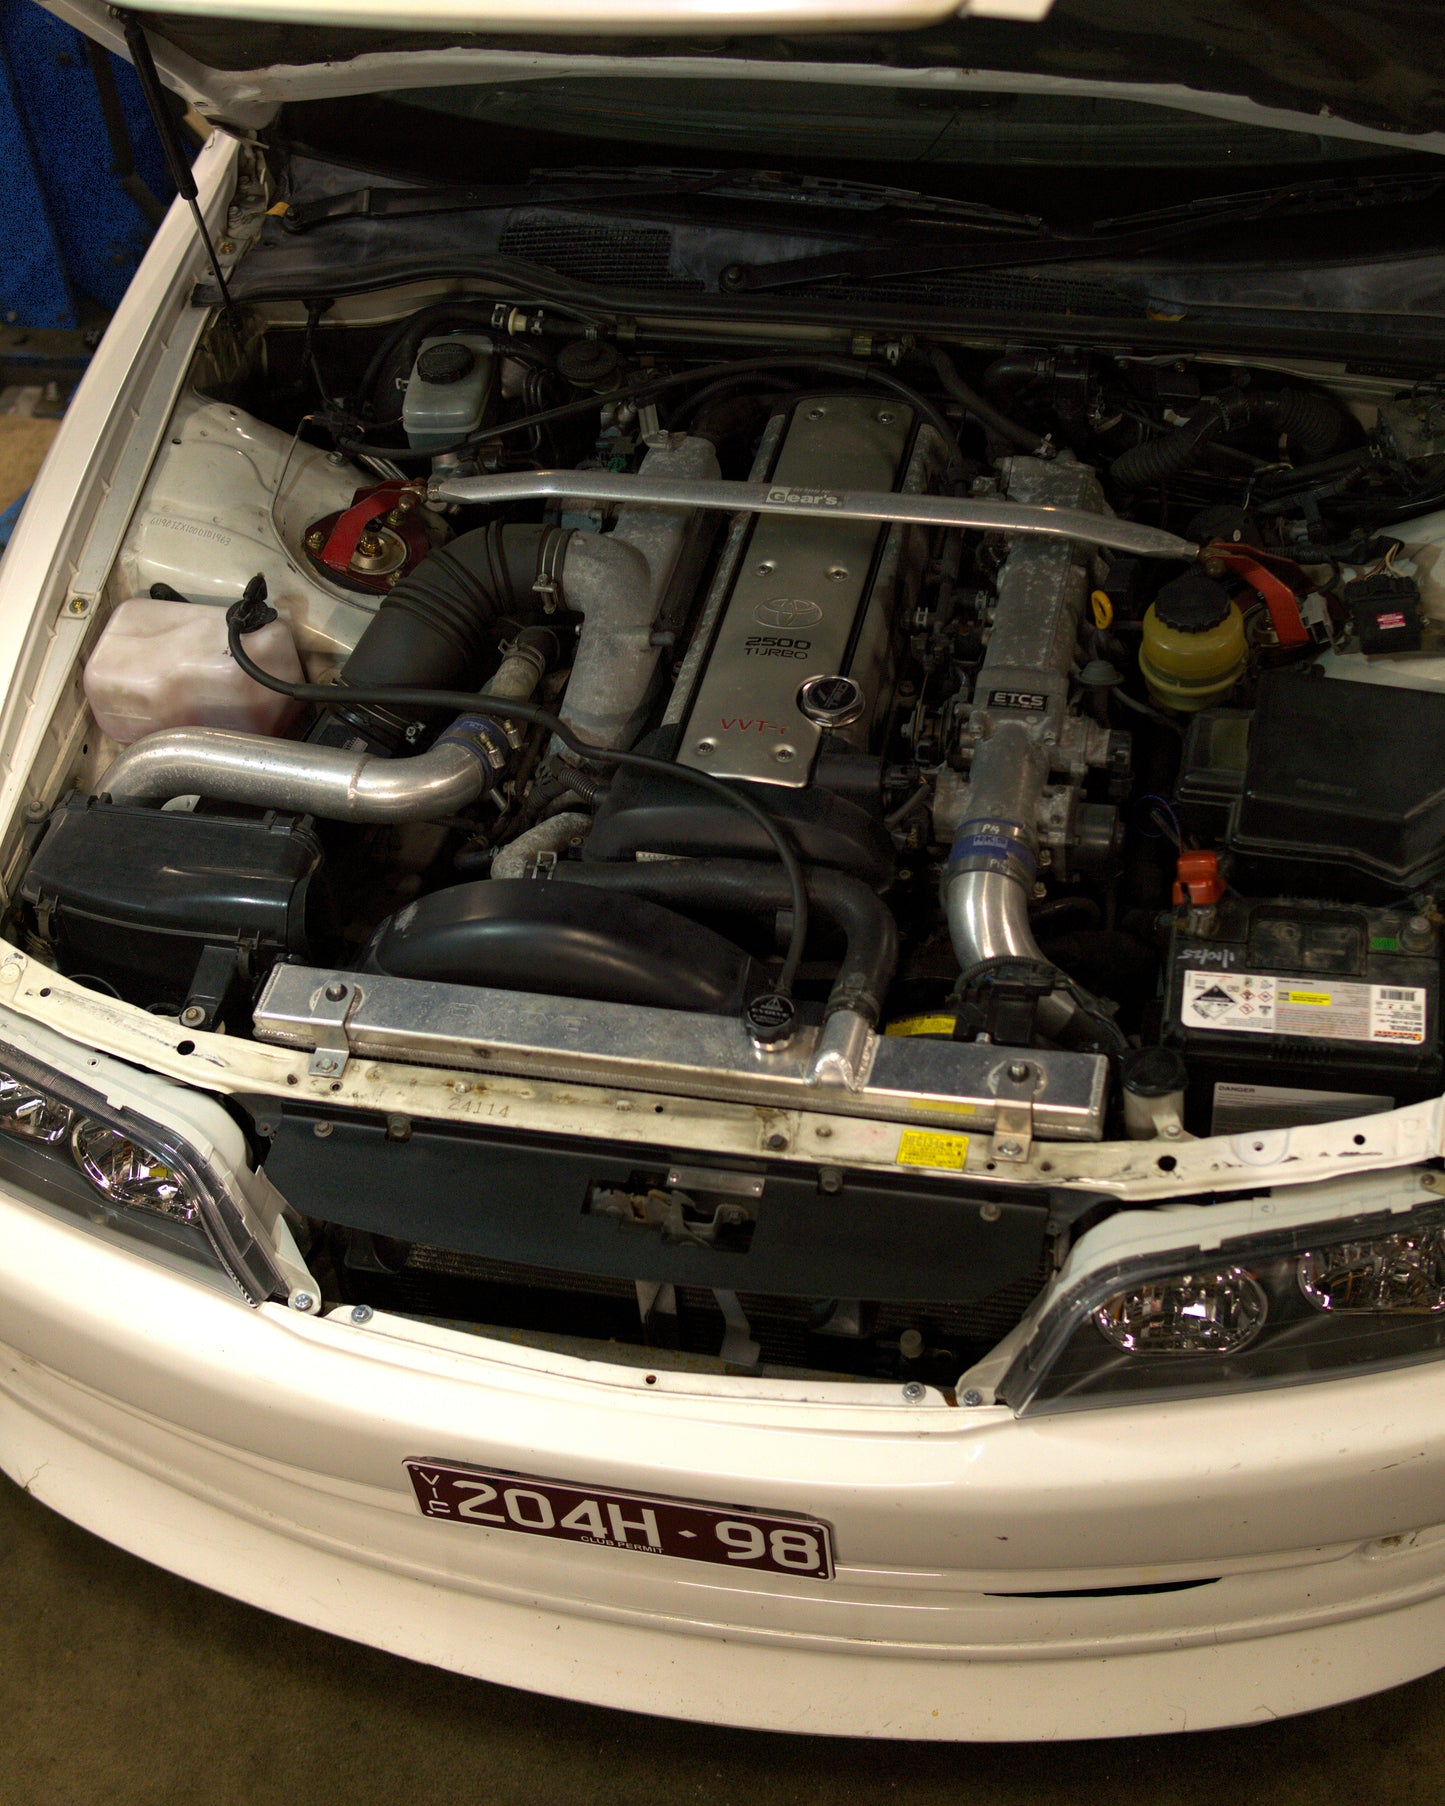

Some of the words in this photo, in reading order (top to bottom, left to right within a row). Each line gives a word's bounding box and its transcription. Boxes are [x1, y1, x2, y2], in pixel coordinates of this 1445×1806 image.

[766, 486, 838, 505] Gear's
[746, 636, 811, 650] 2500
[745, 648, 809, 660] TURBO
[993, 692, 1044, 706] ETCS
[720, 718, 786, 734] VVT-i
[1218, 1085, 1256, 1093] DANGER
[447, 1096, 509, 1118] 24114
[420, 1471, 450, 1514] VIC
[451, 1480, 661, 1547] 204H
[714, 1521, 823, 1571] 98
[580, 1536, 614, 1545] CLUB
[617, 1542, 664, 1554] PERMIT
